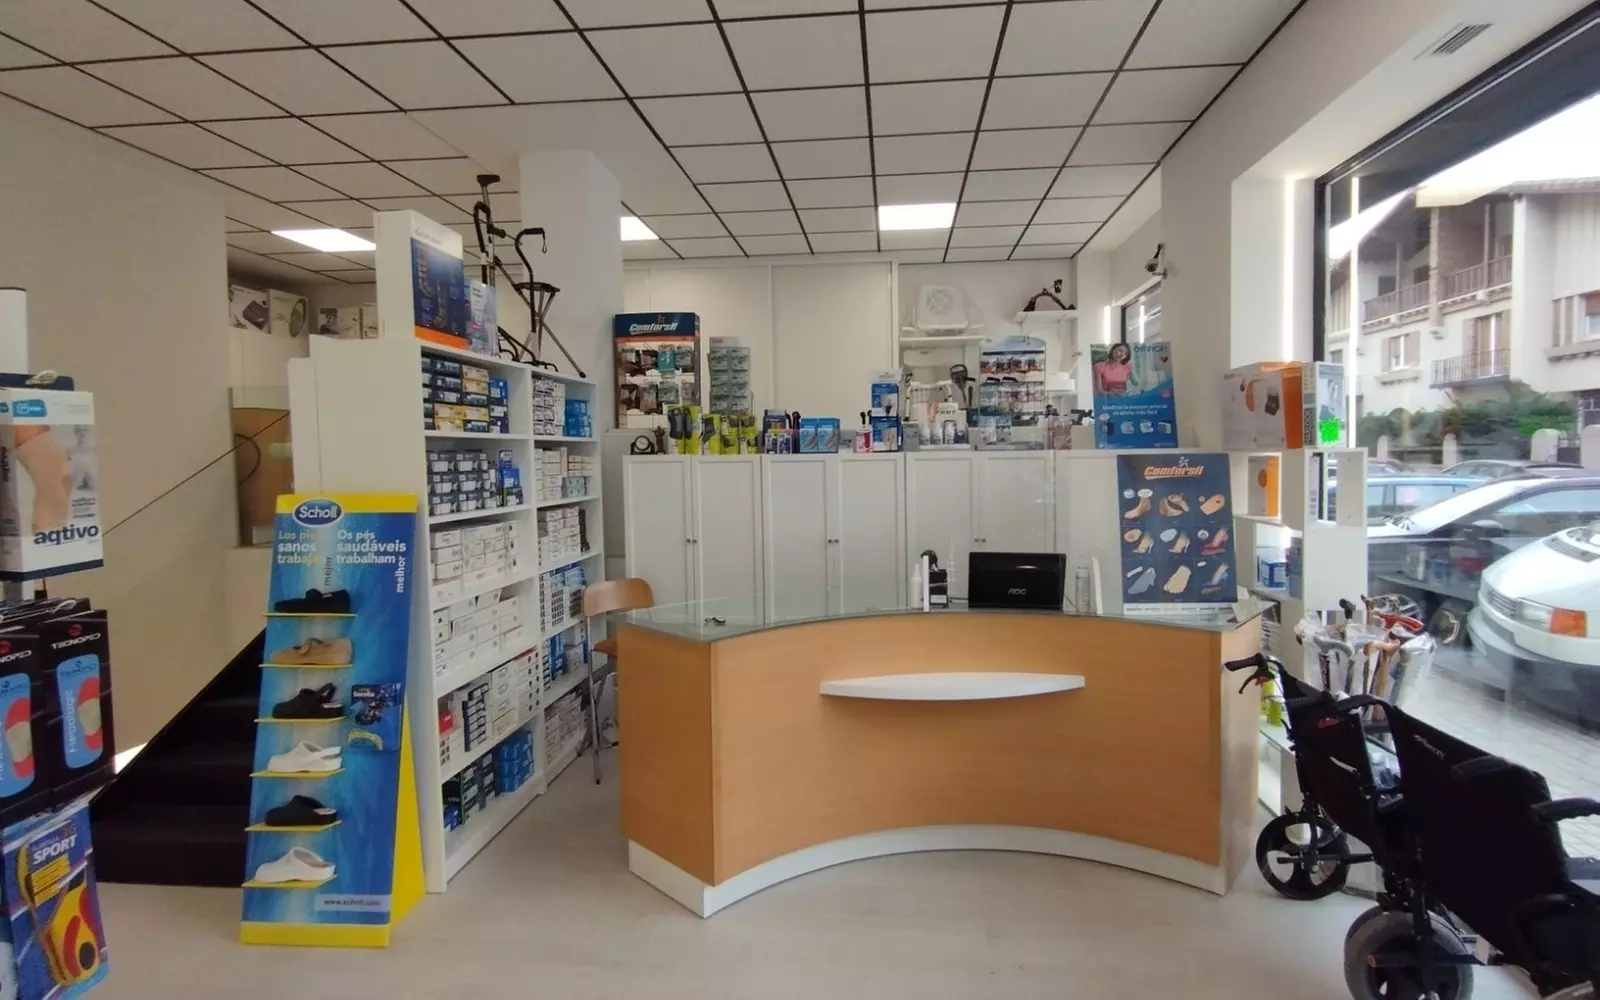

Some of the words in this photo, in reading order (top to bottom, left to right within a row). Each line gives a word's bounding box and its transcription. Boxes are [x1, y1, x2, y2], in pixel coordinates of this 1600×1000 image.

[298, 505, 338, 519] Scholl
[34, 523, 99, 546] aqtivo
[278, 530, 297, 541] Los
[337, 529, 354, 540] Os
[356, 529, 376, 543] pés
[277, 542, 316, 553] sanos
[336, 540, 407, 553] saudáveis
[277, 554, 324, 567] trabaj
[336, 554, 396, 565] trabalham
[394, 556, 406, 594] melhor
[1008, 587, 1027, 595] AOC
[51, 632, 101, 650] TECNOPED
[32, 834, 78, 865] SPORT
